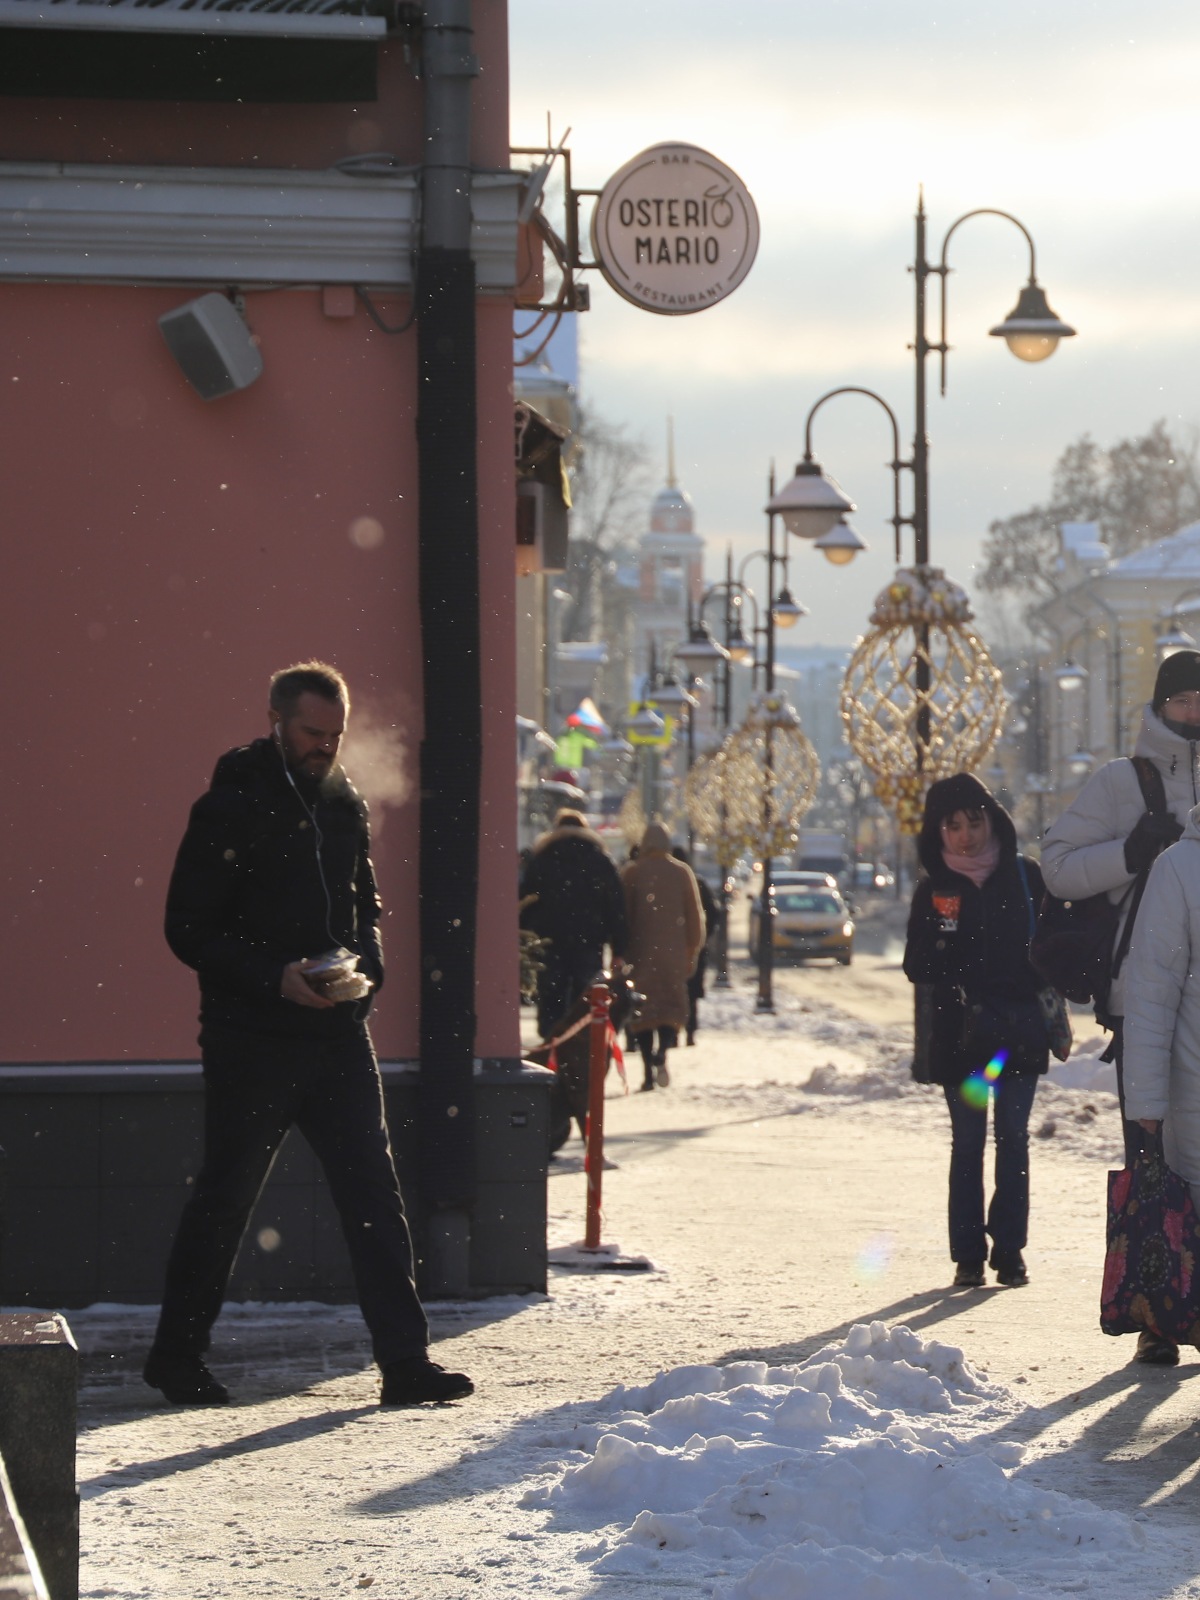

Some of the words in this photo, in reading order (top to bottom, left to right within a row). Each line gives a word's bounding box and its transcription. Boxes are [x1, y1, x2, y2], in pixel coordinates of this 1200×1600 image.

[661, 154, 691, 165] BAR
[635, 236, 720, 265] MARIO
[633, 281, 724, 305] RESTAURANT
